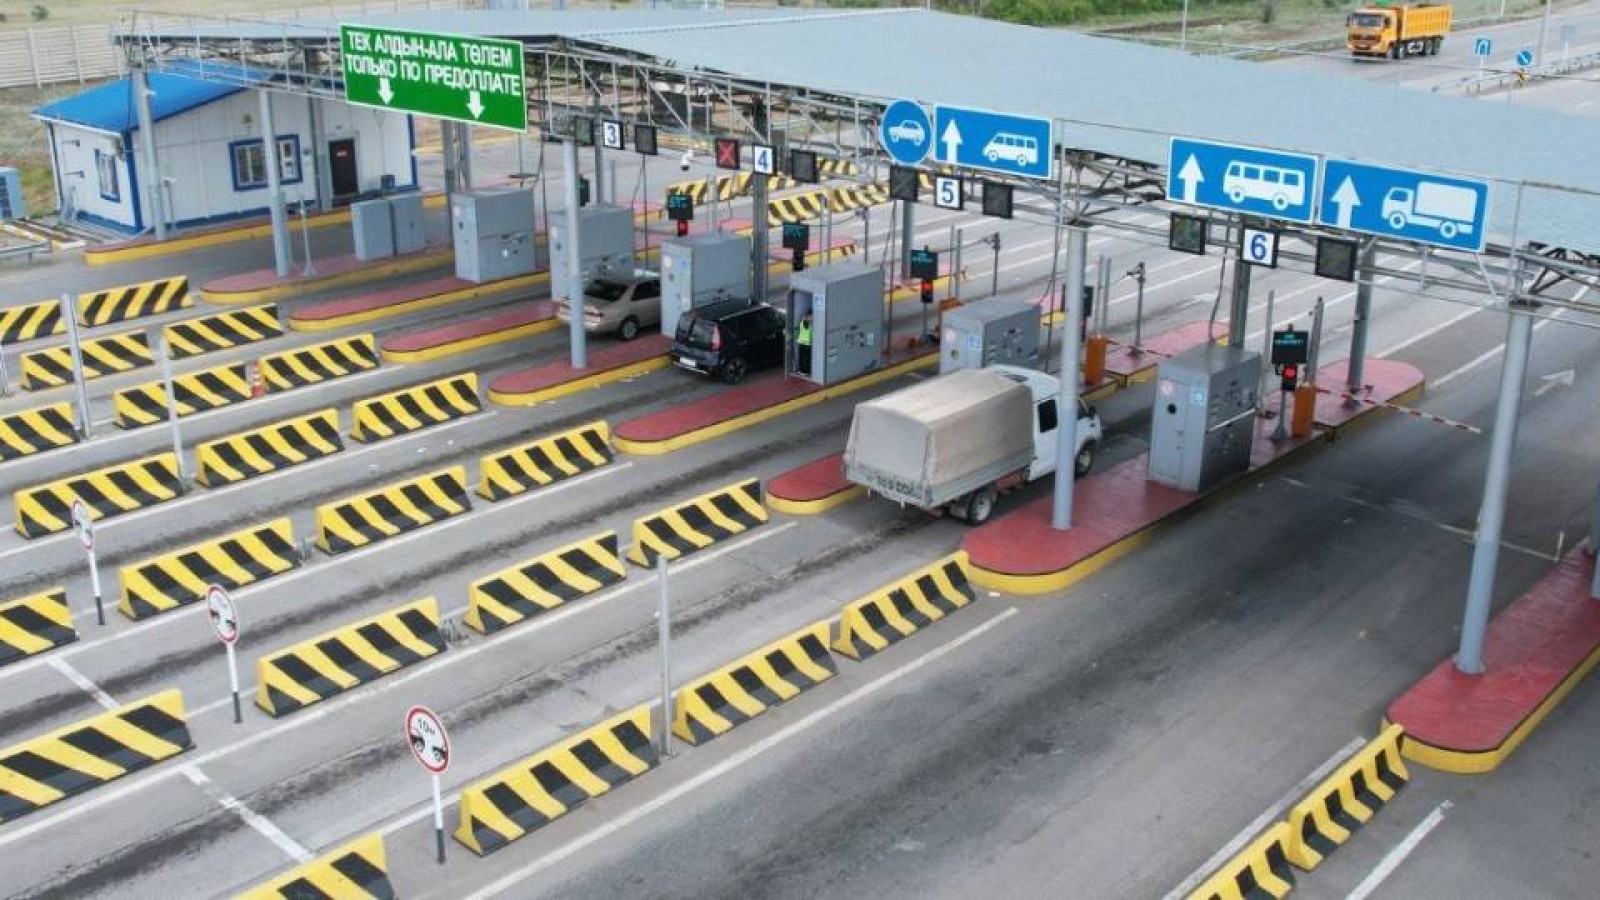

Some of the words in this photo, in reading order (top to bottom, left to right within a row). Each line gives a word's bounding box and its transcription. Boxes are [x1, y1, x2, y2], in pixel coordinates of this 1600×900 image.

[346, 30, 371, 51] ТЕК
[374, 33, 458, 62] АЛДЫН-АЛА
[460, 42, 514, 68] ТӨЛЕМ
[344, 53, 397, 78] ТОЛЬКО
[401, 60, 421, 81] ПО
[424, 63, 521, 96] ПРЕДОПЛАТЕ
[606, 124, 616, 144] 3
[756, 147, 769, 169] 4
[942, 180, 954, 204] 5
[1250, 234, 1267, 261] 6
